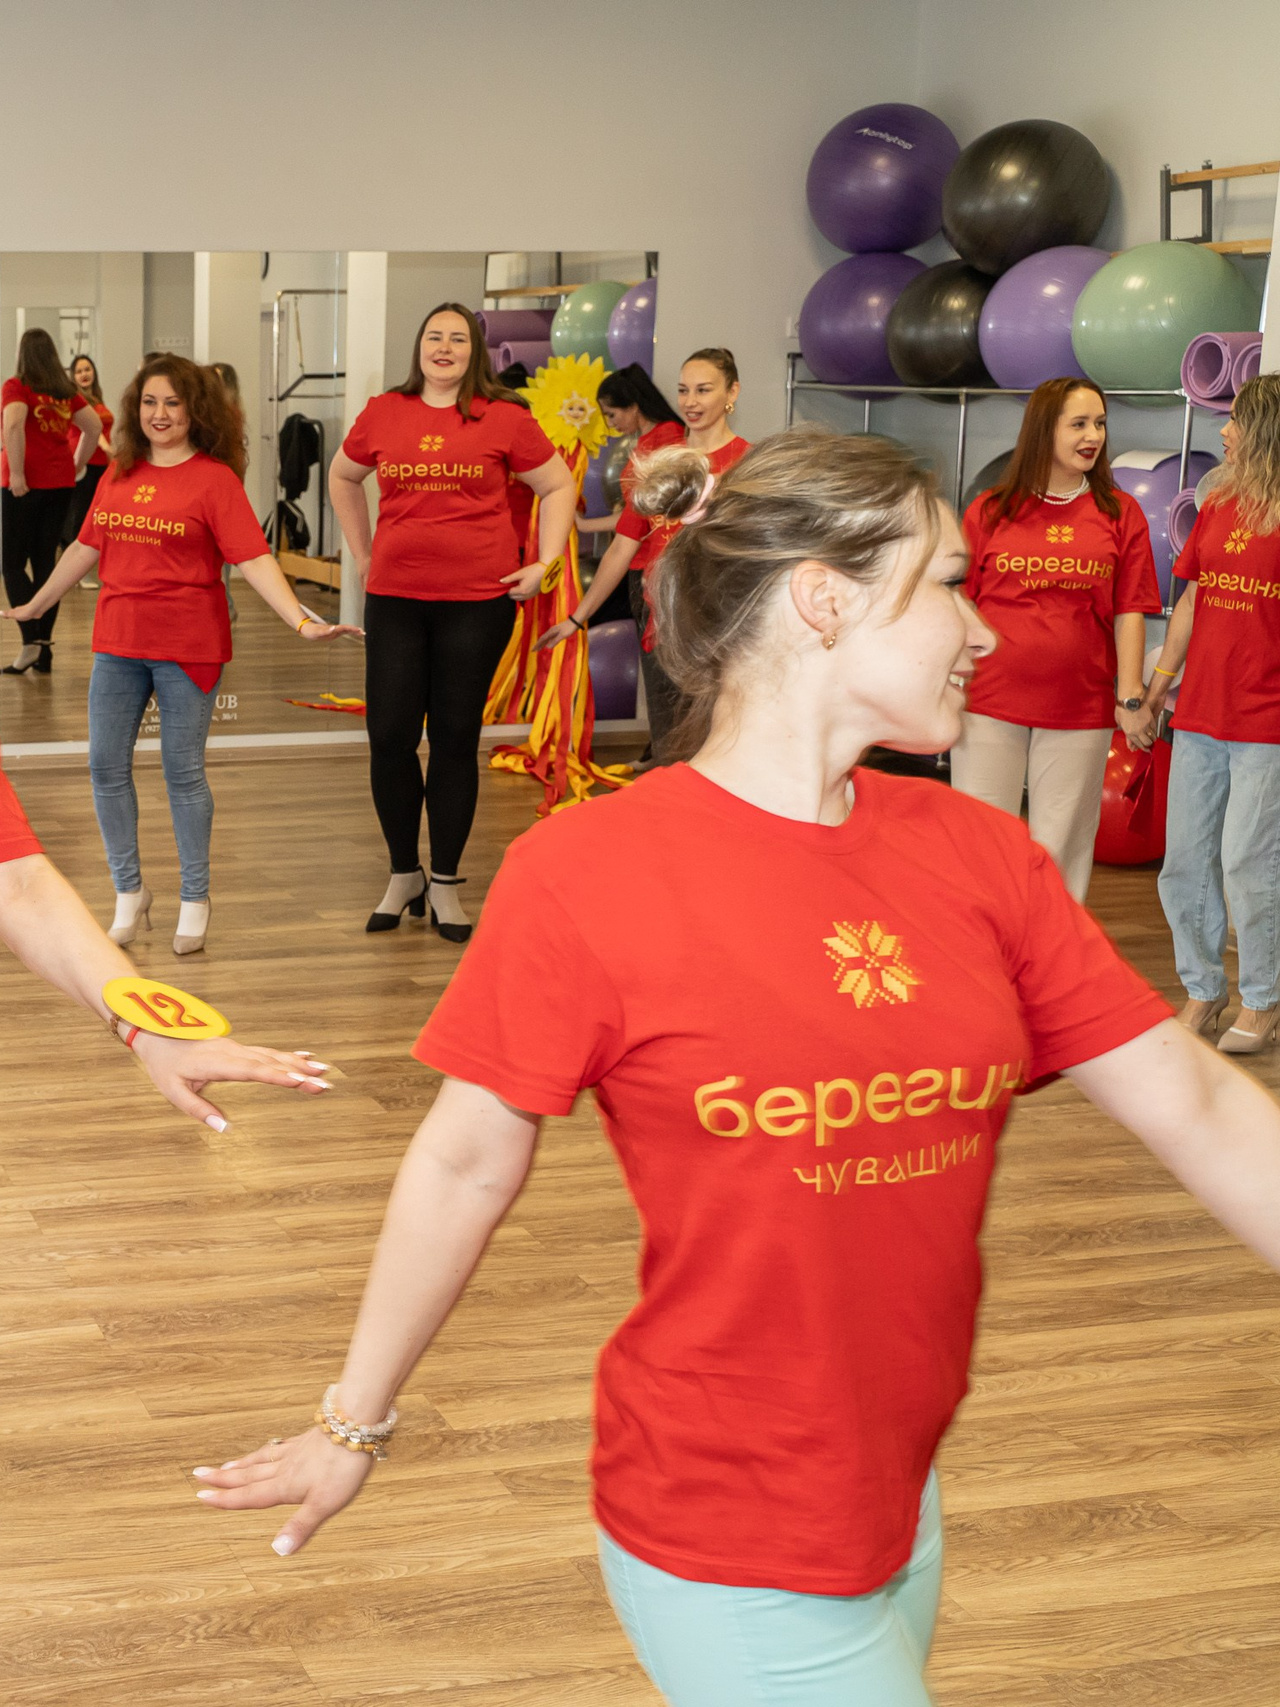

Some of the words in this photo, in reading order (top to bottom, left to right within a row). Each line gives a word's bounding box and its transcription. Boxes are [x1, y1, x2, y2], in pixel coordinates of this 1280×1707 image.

[380, 461, 484, 480] берегиня
[396, 482, 461, 492] чувашии
[105, 532, 162, 546] чувашии
[995, 552, 1114, 580] берегиня
[1198, 571, 1280, 599] ерегиня
[121, 991, 208, 1028] 12
[693, 1060, 1024, 1147] берегин
[793, 1133, 982, 1195] чувашии
